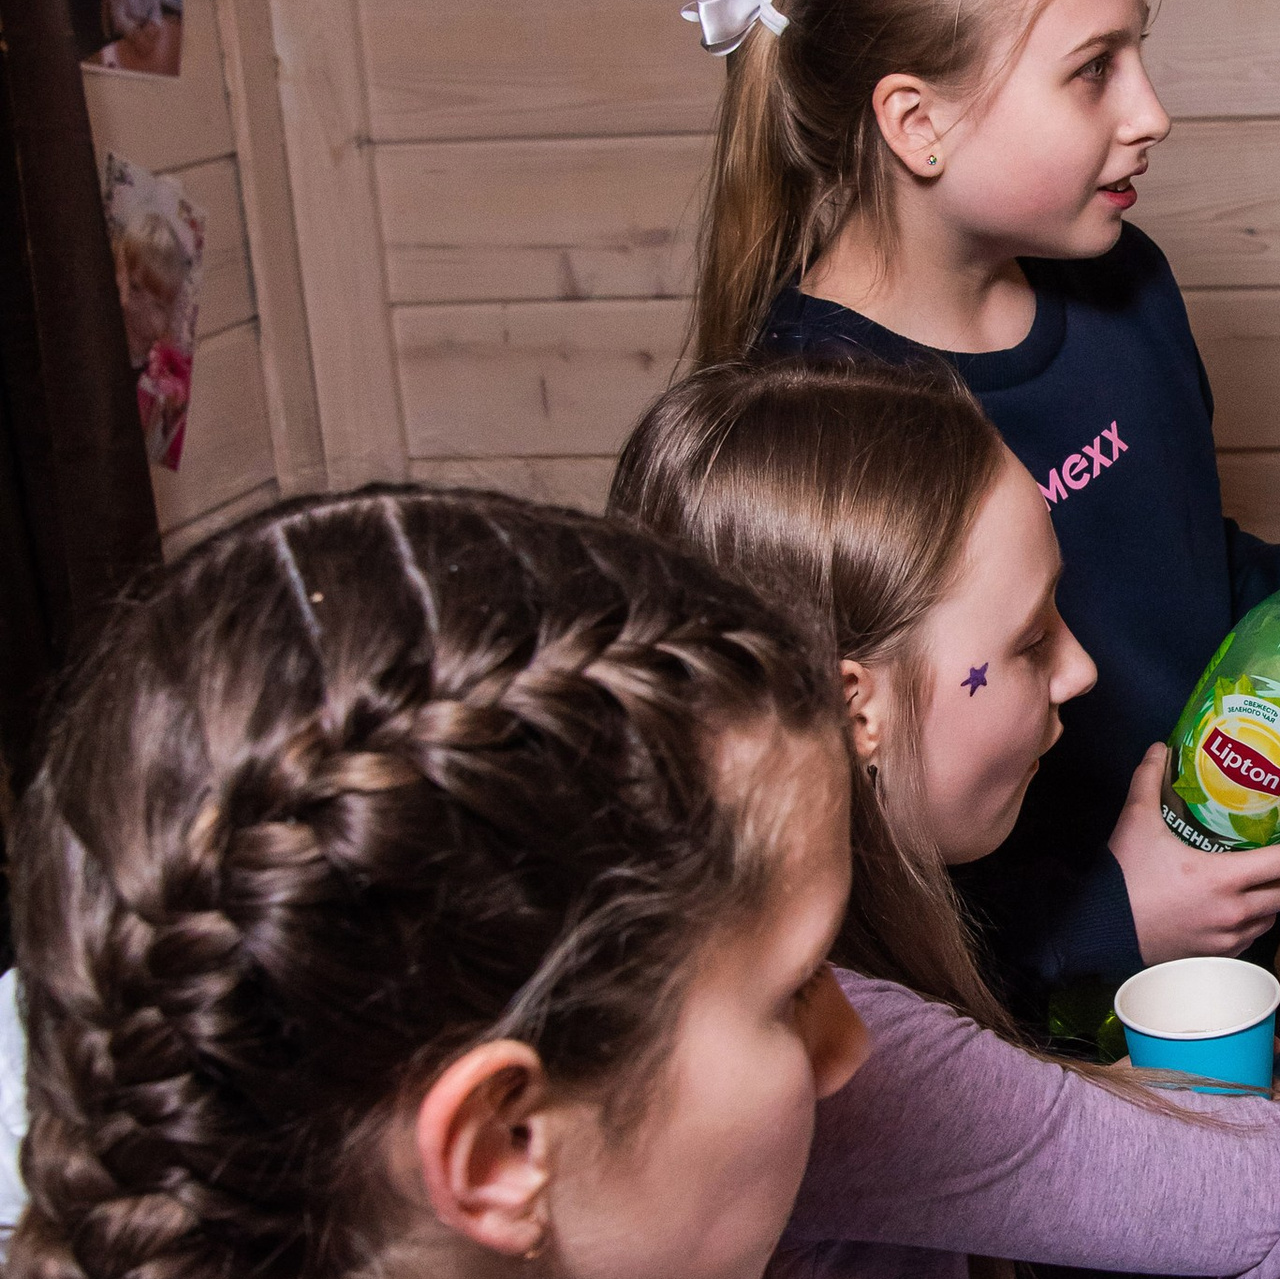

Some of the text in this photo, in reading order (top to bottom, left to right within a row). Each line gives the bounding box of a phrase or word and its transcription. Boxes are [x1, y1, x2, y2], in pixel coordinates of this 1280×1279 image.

[1227, 706, 1276, 724] ЗЕЛЕНОГО ЧАЯ
[1243, 699, 1279, 718] СВЕЖЕСТЬ
[1210, 735, 1280, 790] Lipton
